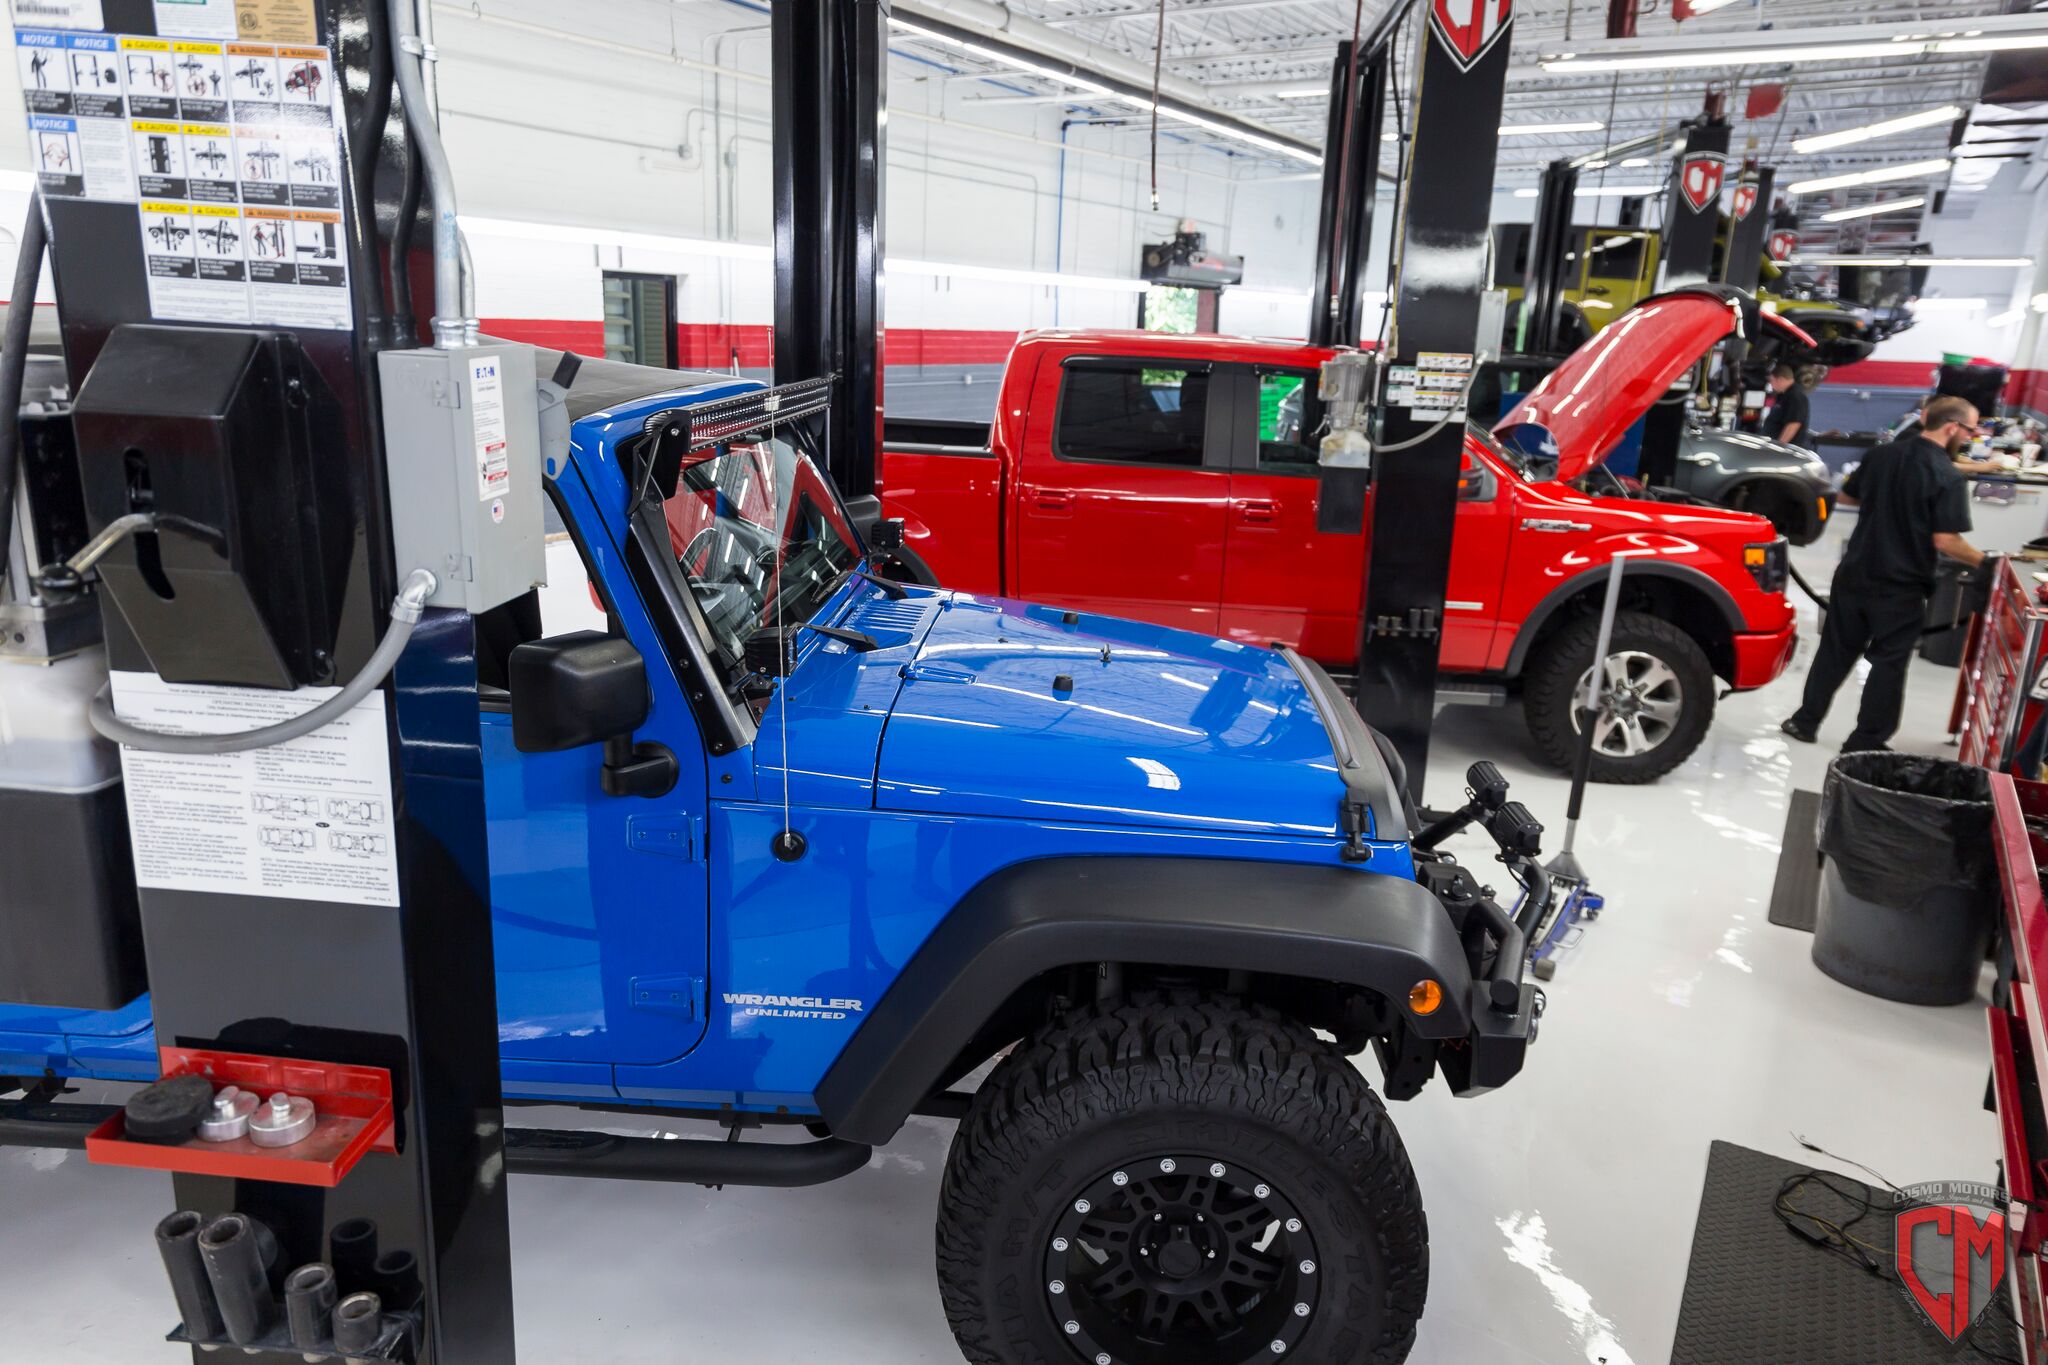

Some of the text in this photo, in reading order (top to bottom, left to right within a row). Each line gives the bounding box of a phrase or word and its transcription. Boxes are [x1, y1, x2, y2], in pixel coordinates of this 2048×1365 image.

[21, 33, 57, 46] NOTICE
[74, 37, 109, 49] NOTICE
[134, 40, 167, 50] CAUTION
[186, 43, 218, 53] CAUTION
[34, 118, 70, 130] NOTICE
[144, 122, 177, 132] CAUTION
[154, 203, 188, 213] CAUTION
[205, 206, 237, 216] CAUTION
[722, 993, 863, 1012] WRANGLER
[744, 1008, 846, 1020] UNLIMITED
